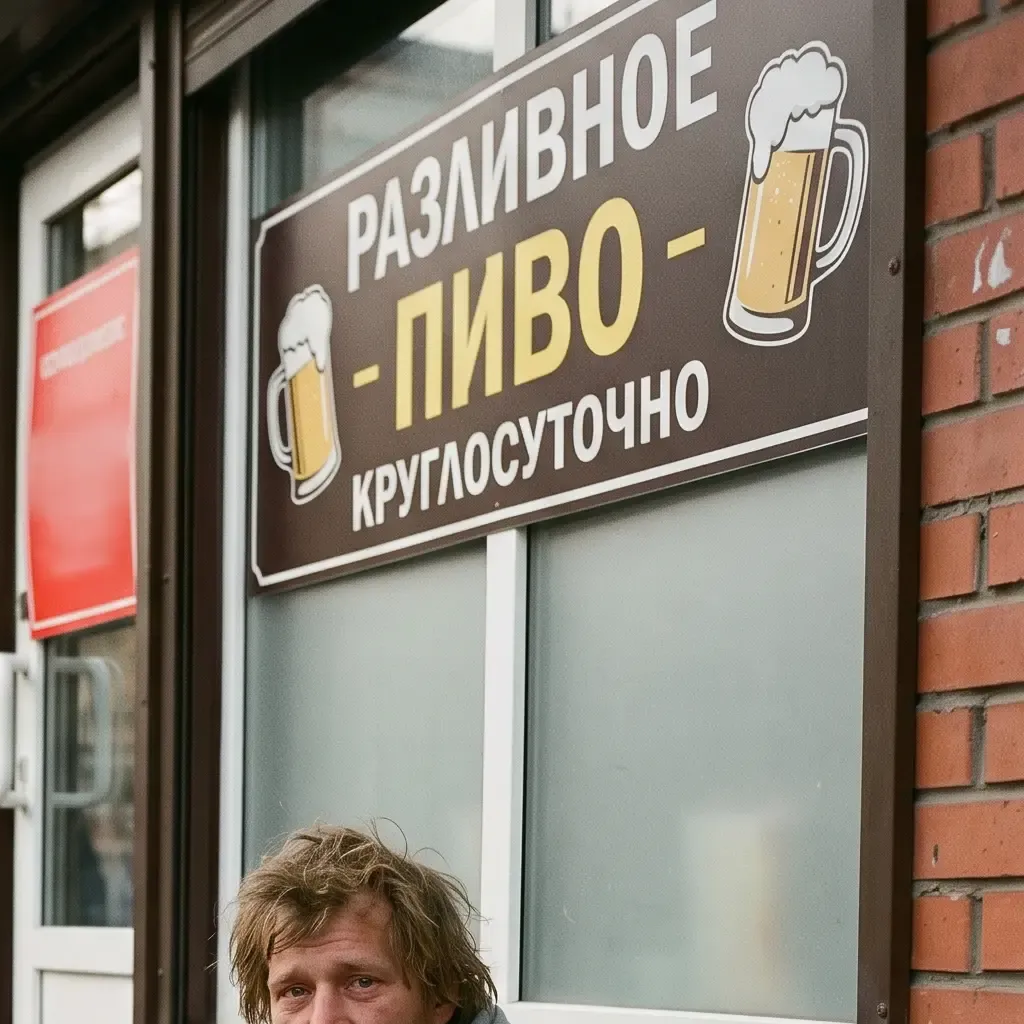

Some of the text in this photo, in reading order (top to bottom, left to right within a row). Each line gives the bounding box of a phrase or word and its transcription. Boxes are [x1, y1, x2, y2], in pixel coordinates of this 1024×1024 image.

[347, 0, 718, 293] РАЗЛИВНОЕ
[395, 197, 644, 431] ПИВО
[352, 359, 709, 532] КРУГЛОСУТОЧНО
